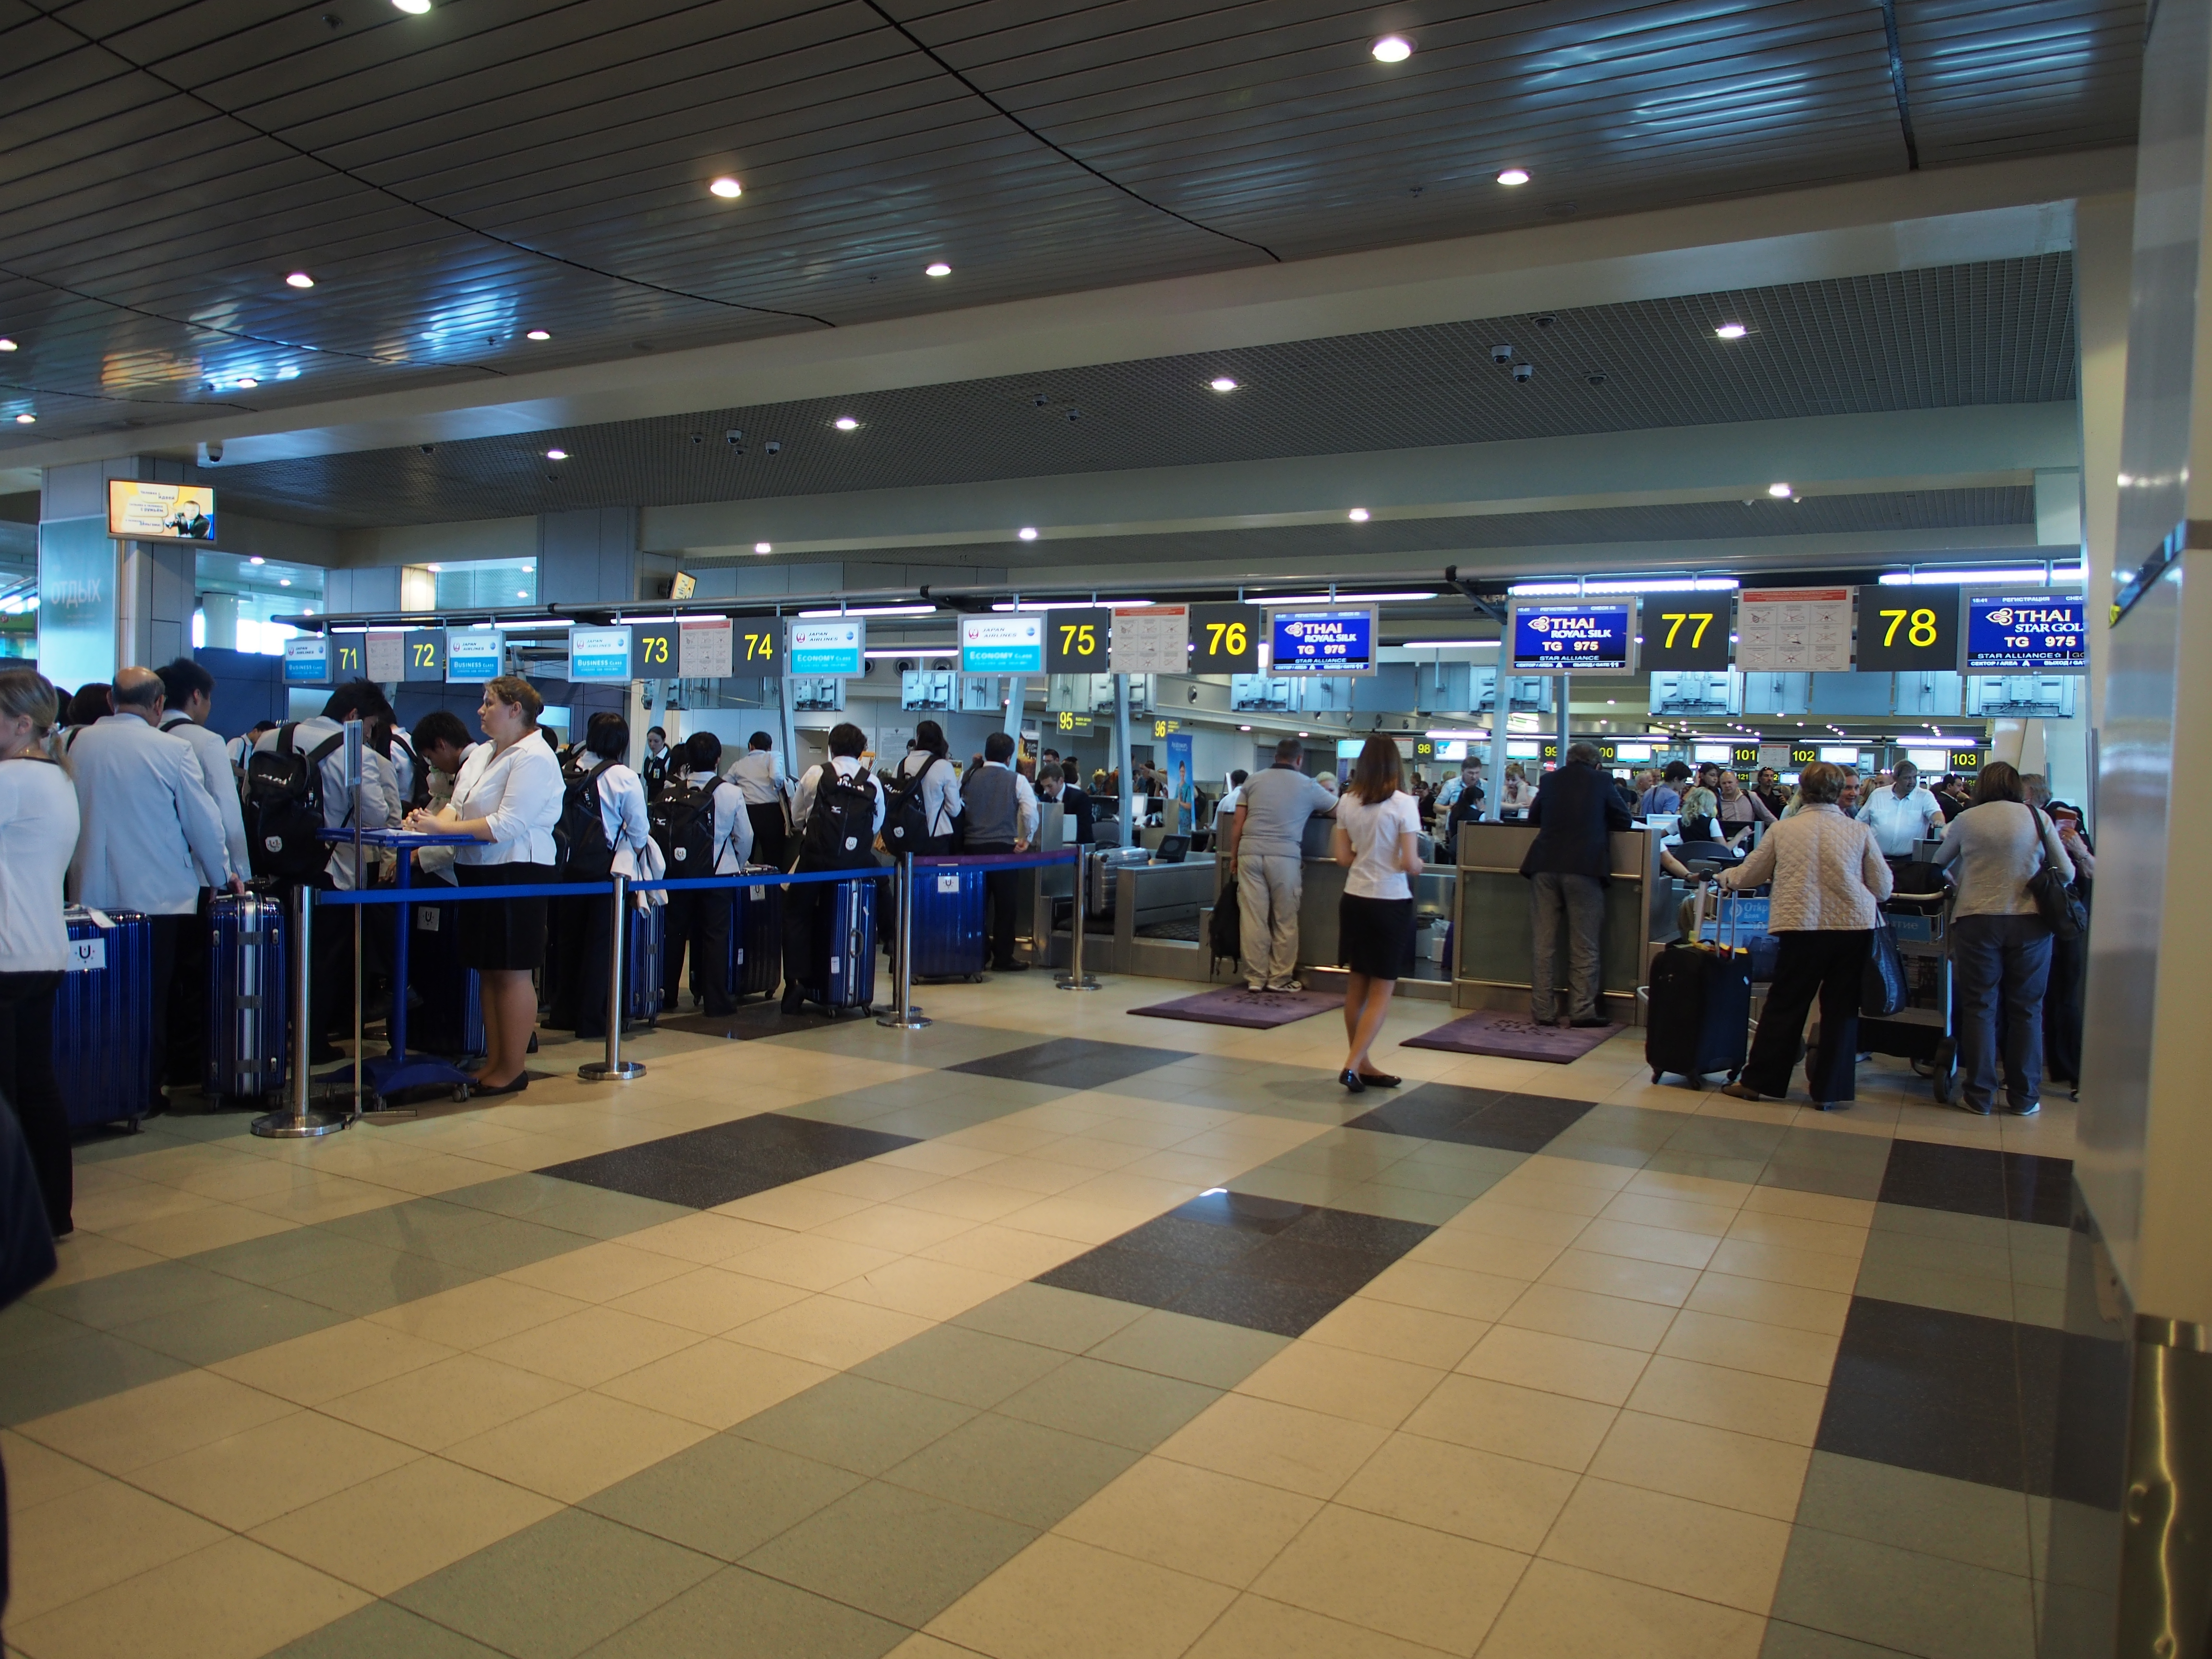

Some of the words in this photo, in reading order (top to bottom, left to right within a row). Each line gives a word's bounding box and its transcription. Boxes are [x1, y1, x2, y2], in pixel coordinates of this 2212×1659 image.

[51, 578, 101, 609] ОТДЫХ
[2014, 609, 2071, 623] THAI
[1304, 623, 1342, 634] THAI
[1550, 618, 1595, 629] THAI
[1879, 609, 1937, 647] 78
[2015, 624, 2050, 633] STAR
[2051, 623, 2084, 632] GOL
[1551, 630, 1587, 638] ROYAL
[1587, 629, 1612, 638] SILK
[1661, 613, 1713, 649] 77
[1060, 625, 1095, 655] 75
[1206, 623, 1247, 655] 76
[1304, 634, 1335, 642] ROYAL
[1335, 633, 1357, 642] SILK
[2004, 637, 2030, 647] TG
[2045, 636, 2076, 647] 975
[642, 637, 669, 663] 73
[745, 633, 773, 661] 74
[1297, 645, 1315, 655] TG
[1324, 644, 1346, 654] 975
[1542, 642, 1563, 651] TG
[1574, 641, 1599, 651] 975
[339, 648, 357, 670] 71
[413, 643, 434, 667] 72
[1059, 712, 1073, 730] 95
[1155, 721, 1166, 737] 96
[1418, 744, 1431, 754] 98
[1545, 746, 1558, 757] 99
[1599, 747, 1614, 758] 00
[1735, 749, 1755, 760] 101
[1792, 750, 1815, 762] 102
[1952, 754, 1976, 766] 103
[837, 778, 865, 792] JAN
[425, 911, 432, 922] U
[79, 945, 91, 959] U
